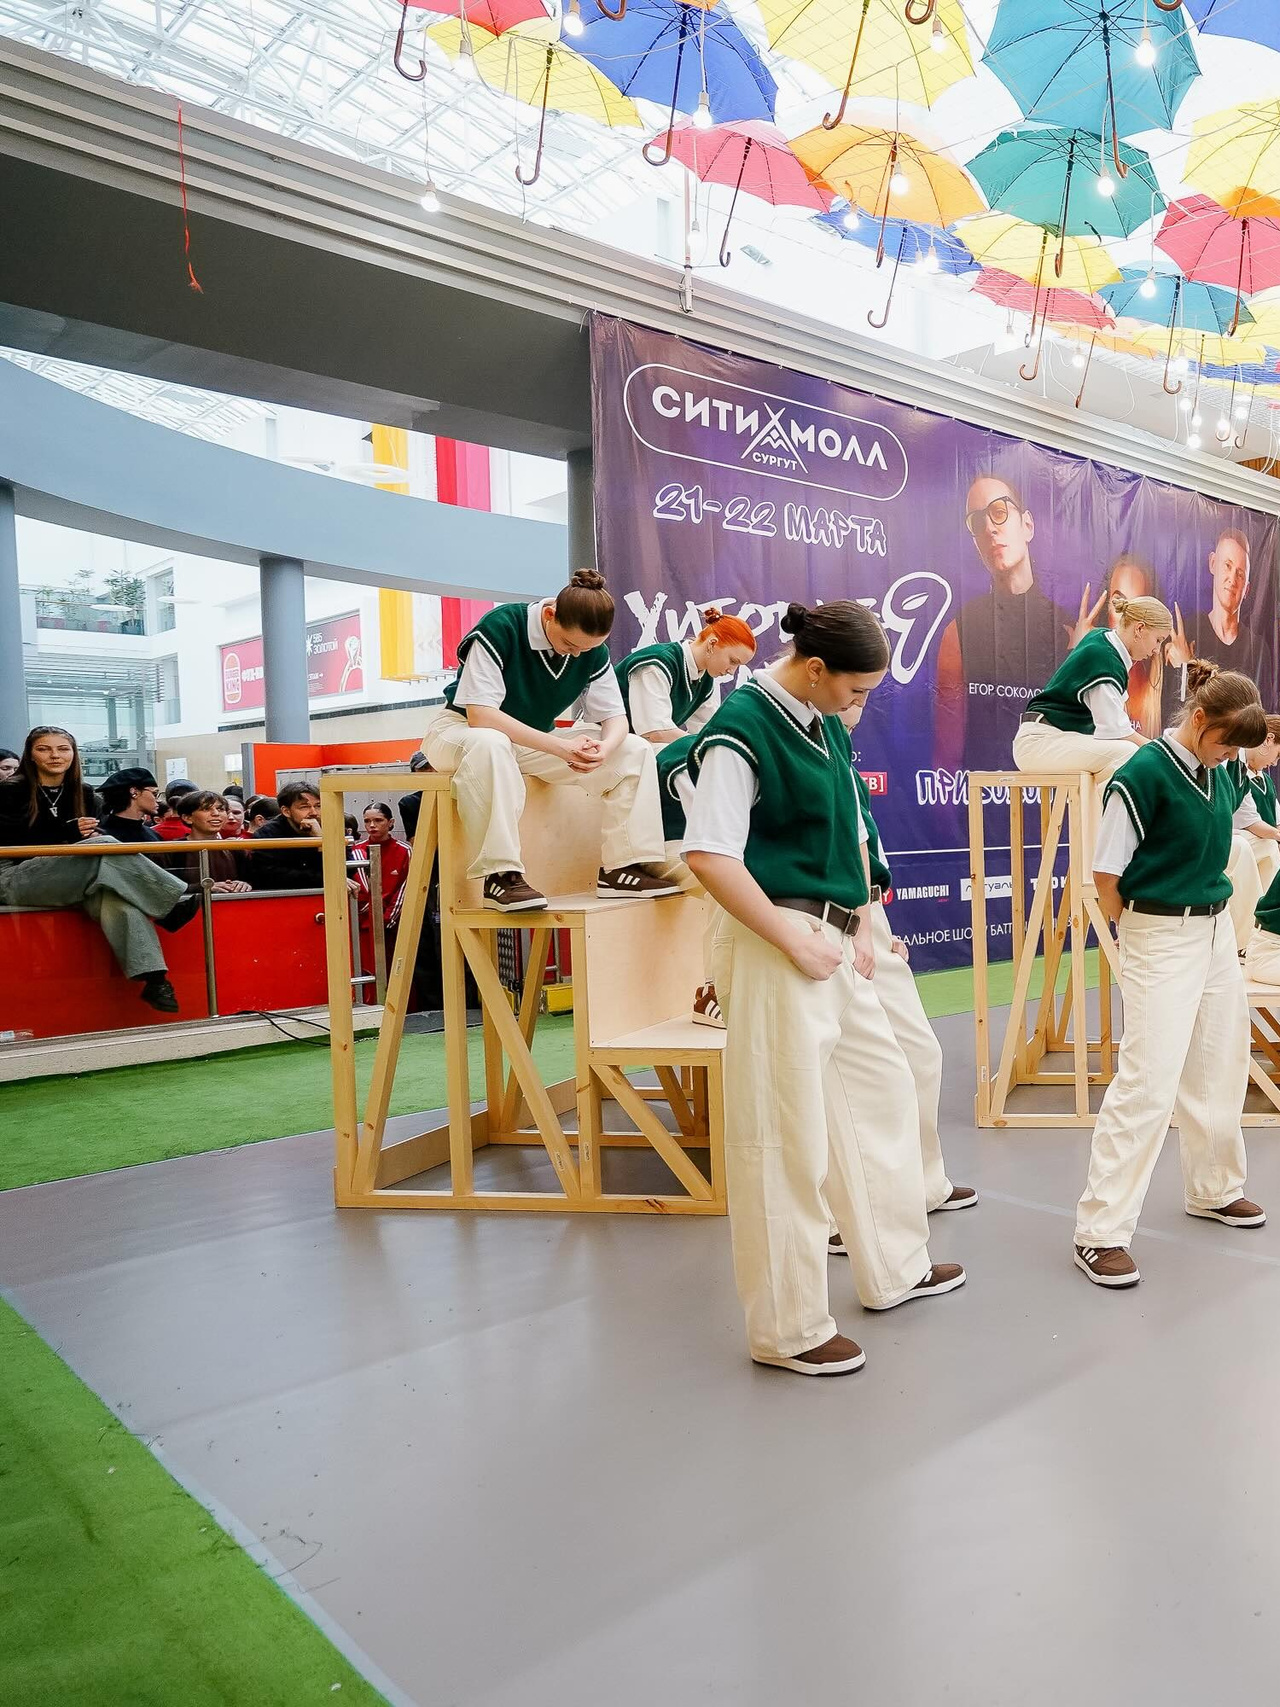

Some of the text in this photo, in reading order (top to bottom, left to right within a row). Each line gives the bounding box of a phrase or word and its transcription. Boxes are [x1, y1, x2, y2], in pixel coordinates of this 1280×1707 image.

[652, 385, 889, 471] СИТИ МОЛЛ
[752, 451, 798, 471] СУРГУТ
[652, 483, 887, 557] 21-22 МАРТА
[968, 682, 1045, 699] ЕГОР СОКОЛО
[896, 884, 950, 901] YAMAGUCHI
